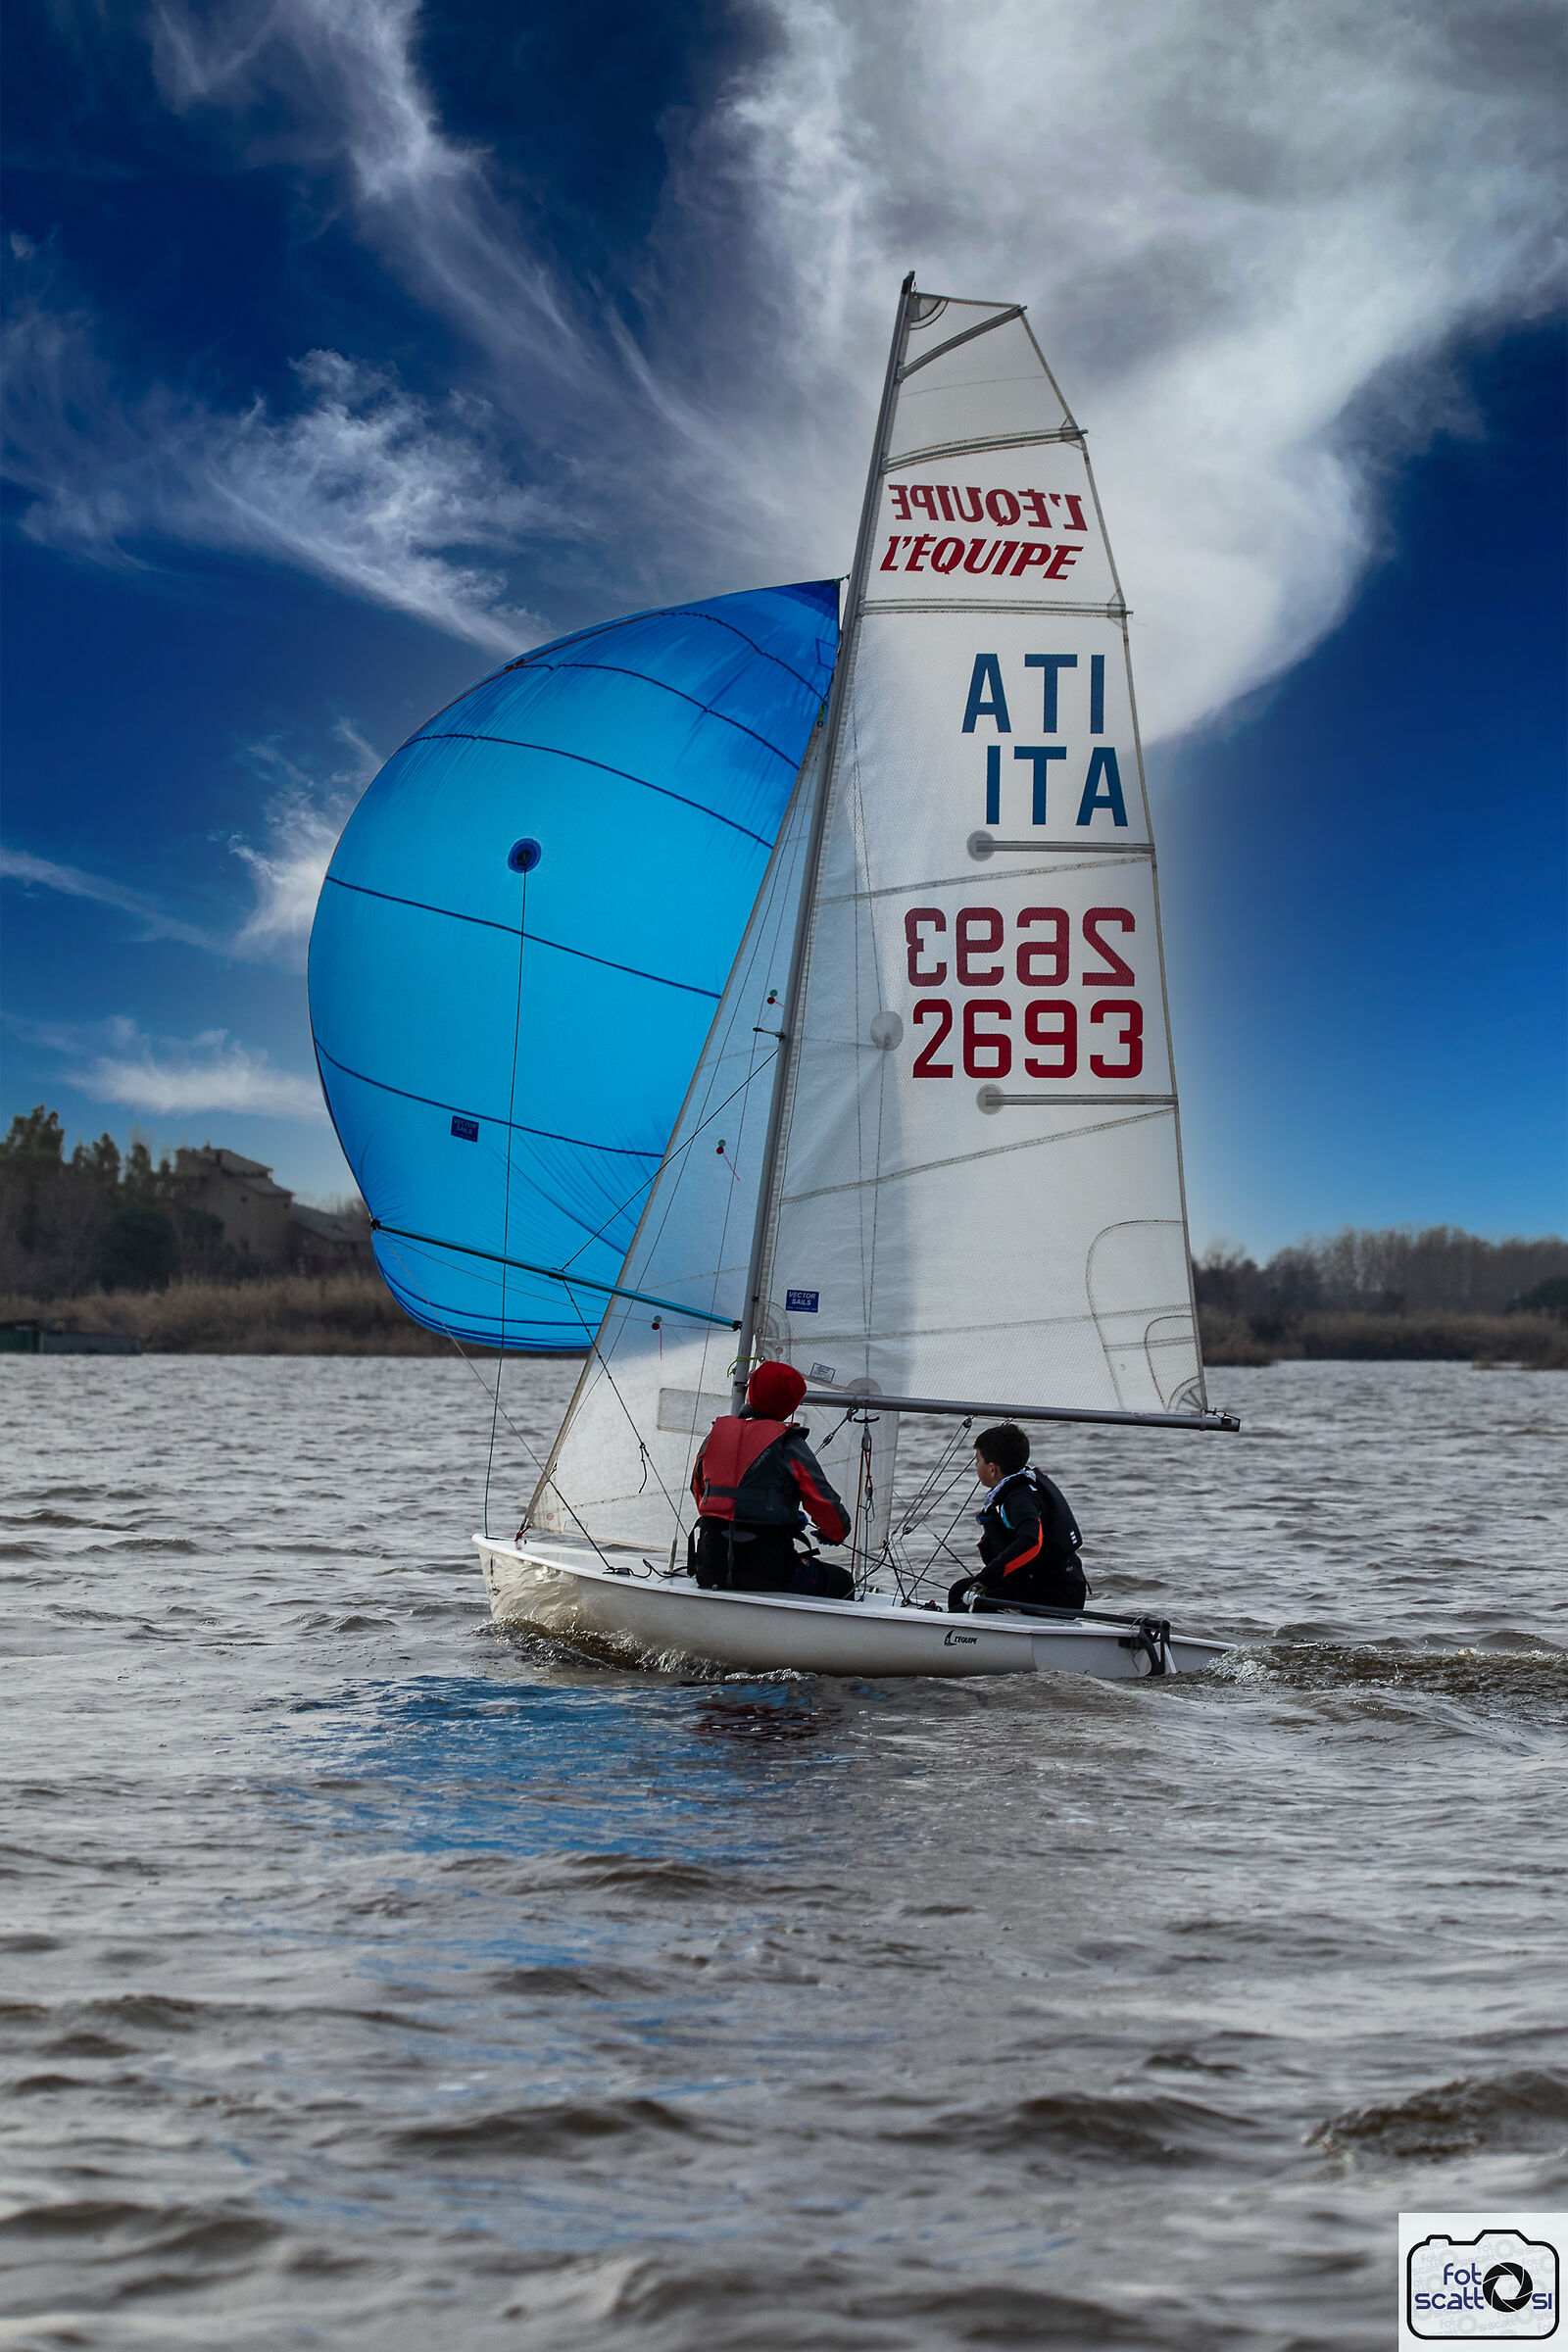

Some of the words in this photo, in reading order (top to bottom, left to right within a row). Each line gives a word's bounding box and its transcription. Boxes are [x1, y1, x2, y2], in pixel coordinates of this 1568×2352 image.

[880, 533, 1084, 580] L'ÉQUIPE
[986, 745, 1128, 826] ITA
[912, 999, 1144, 1079] 2693
